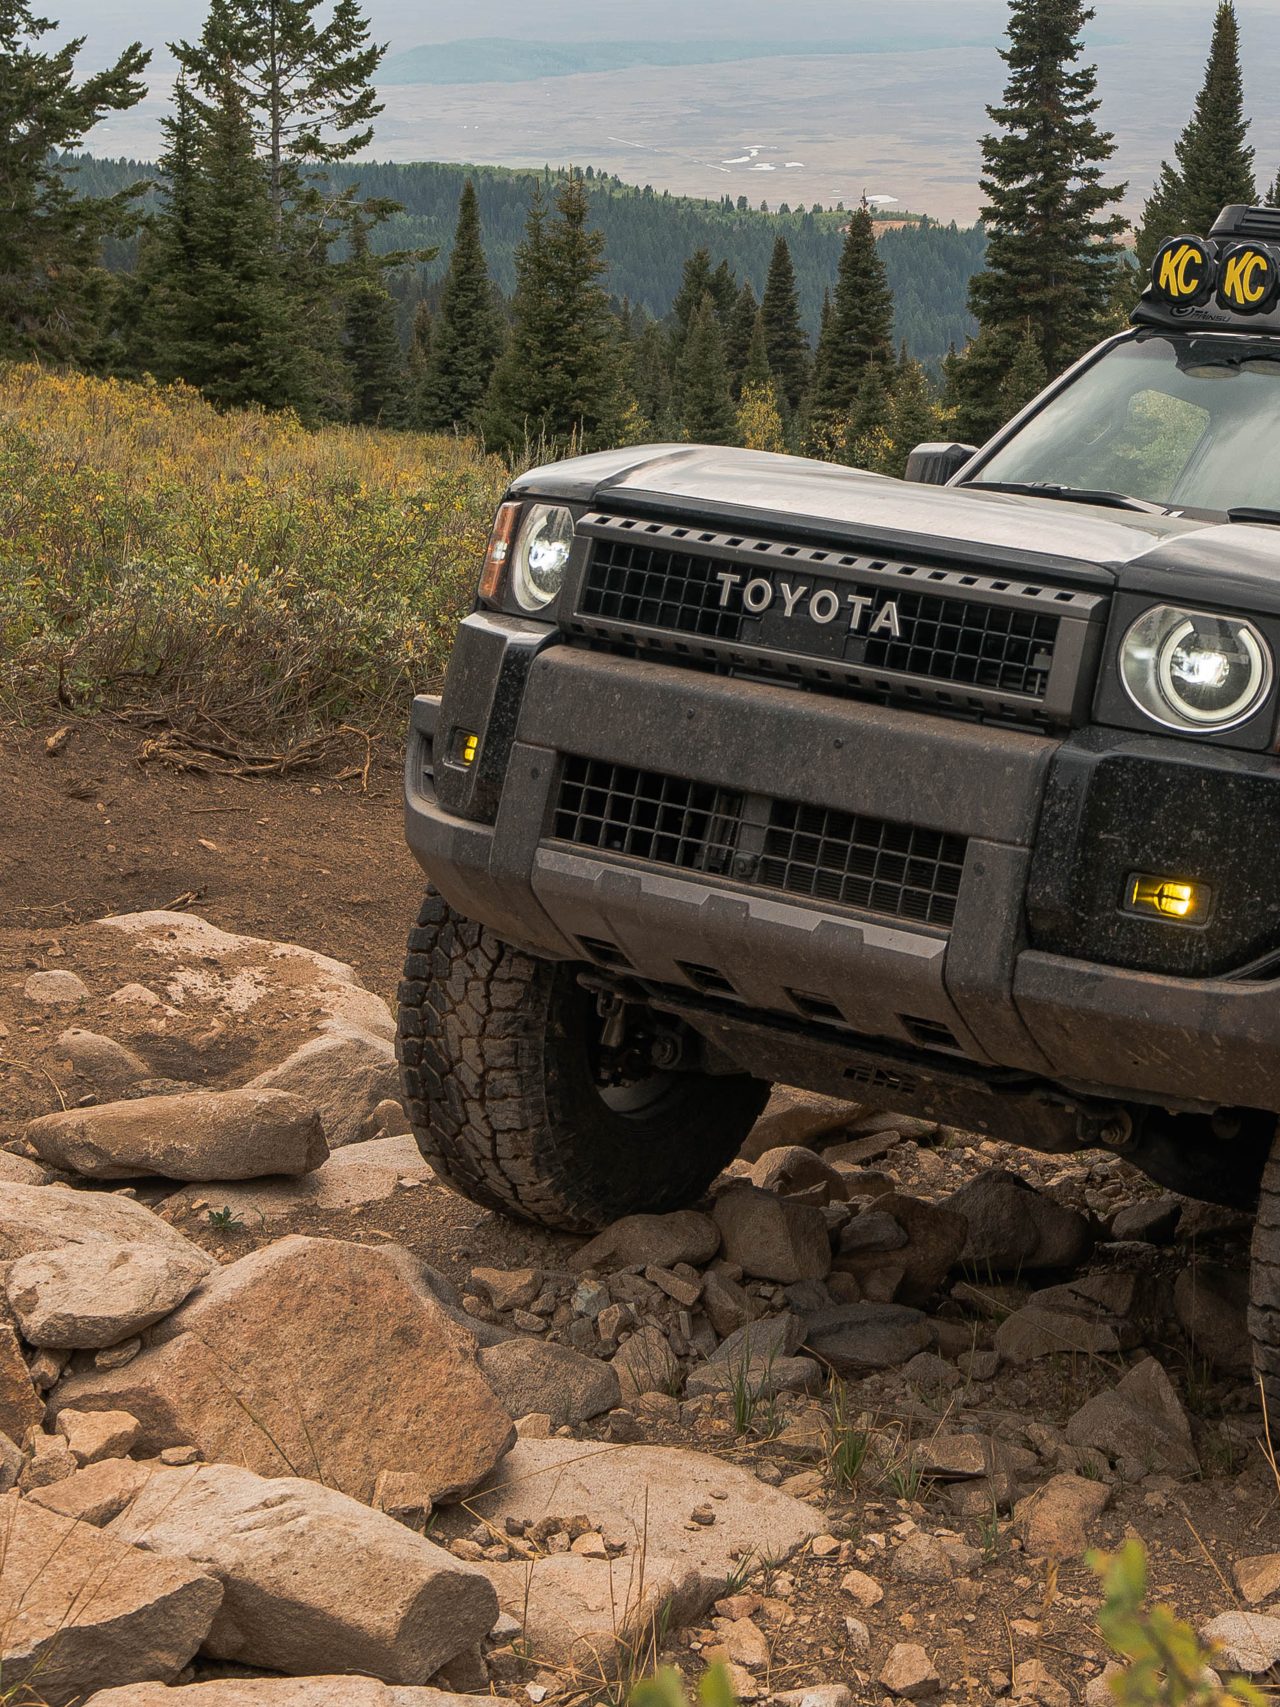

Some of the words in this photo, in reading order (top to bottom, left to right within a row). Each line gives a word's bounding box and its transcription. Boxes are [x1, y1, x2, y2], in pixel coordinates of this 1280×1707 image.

[1159, 244, 1202, 297] KC
[1224, 251, 1267, 304] KC
[716, 572, 900, 637] TOYOTA
